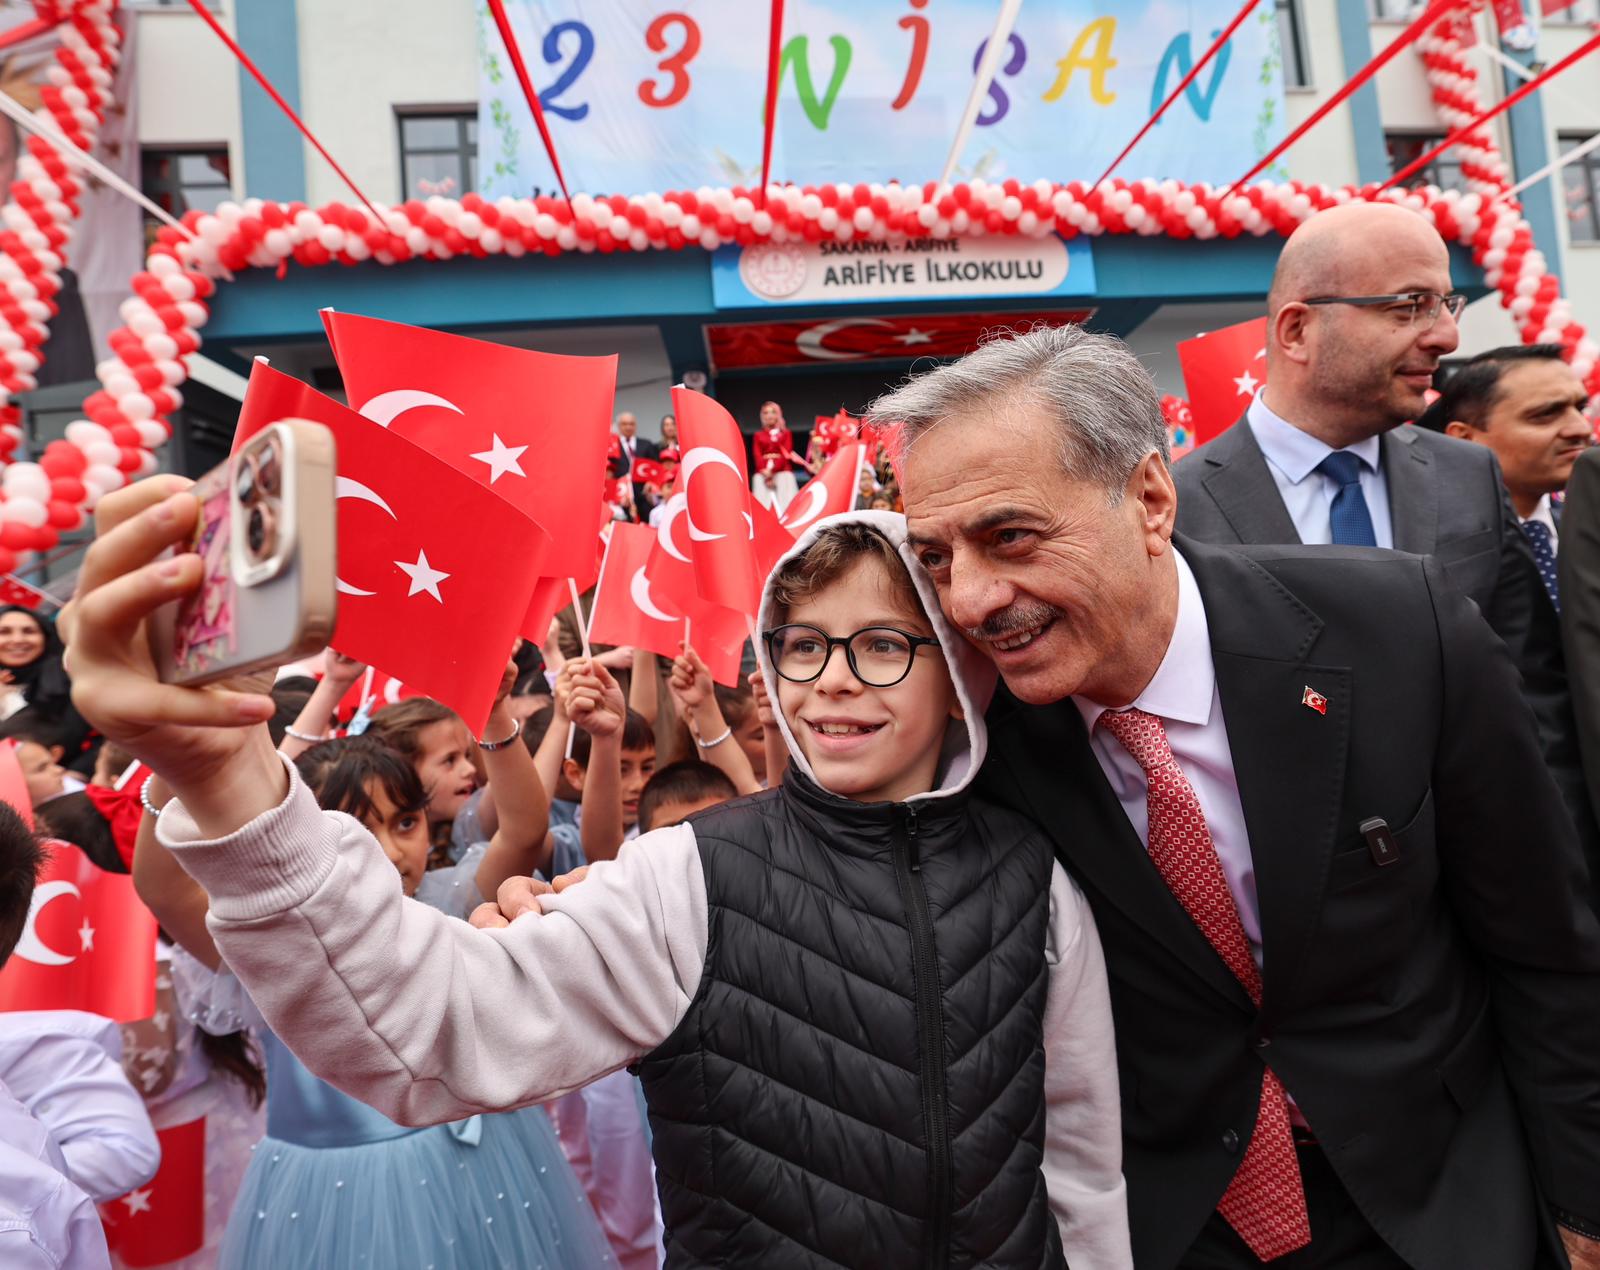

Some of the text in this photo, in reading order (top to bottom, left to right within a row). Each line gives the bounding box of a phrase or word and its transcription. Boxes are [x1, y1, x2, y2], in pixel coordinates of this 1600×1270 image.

[538, 12, 702, 121] 23
[821, 239, 890, 256] SAKARYA
[824, 259, 915, 286] ARİFİYE
[926, 258, 1043, 282] İLKOKULU
